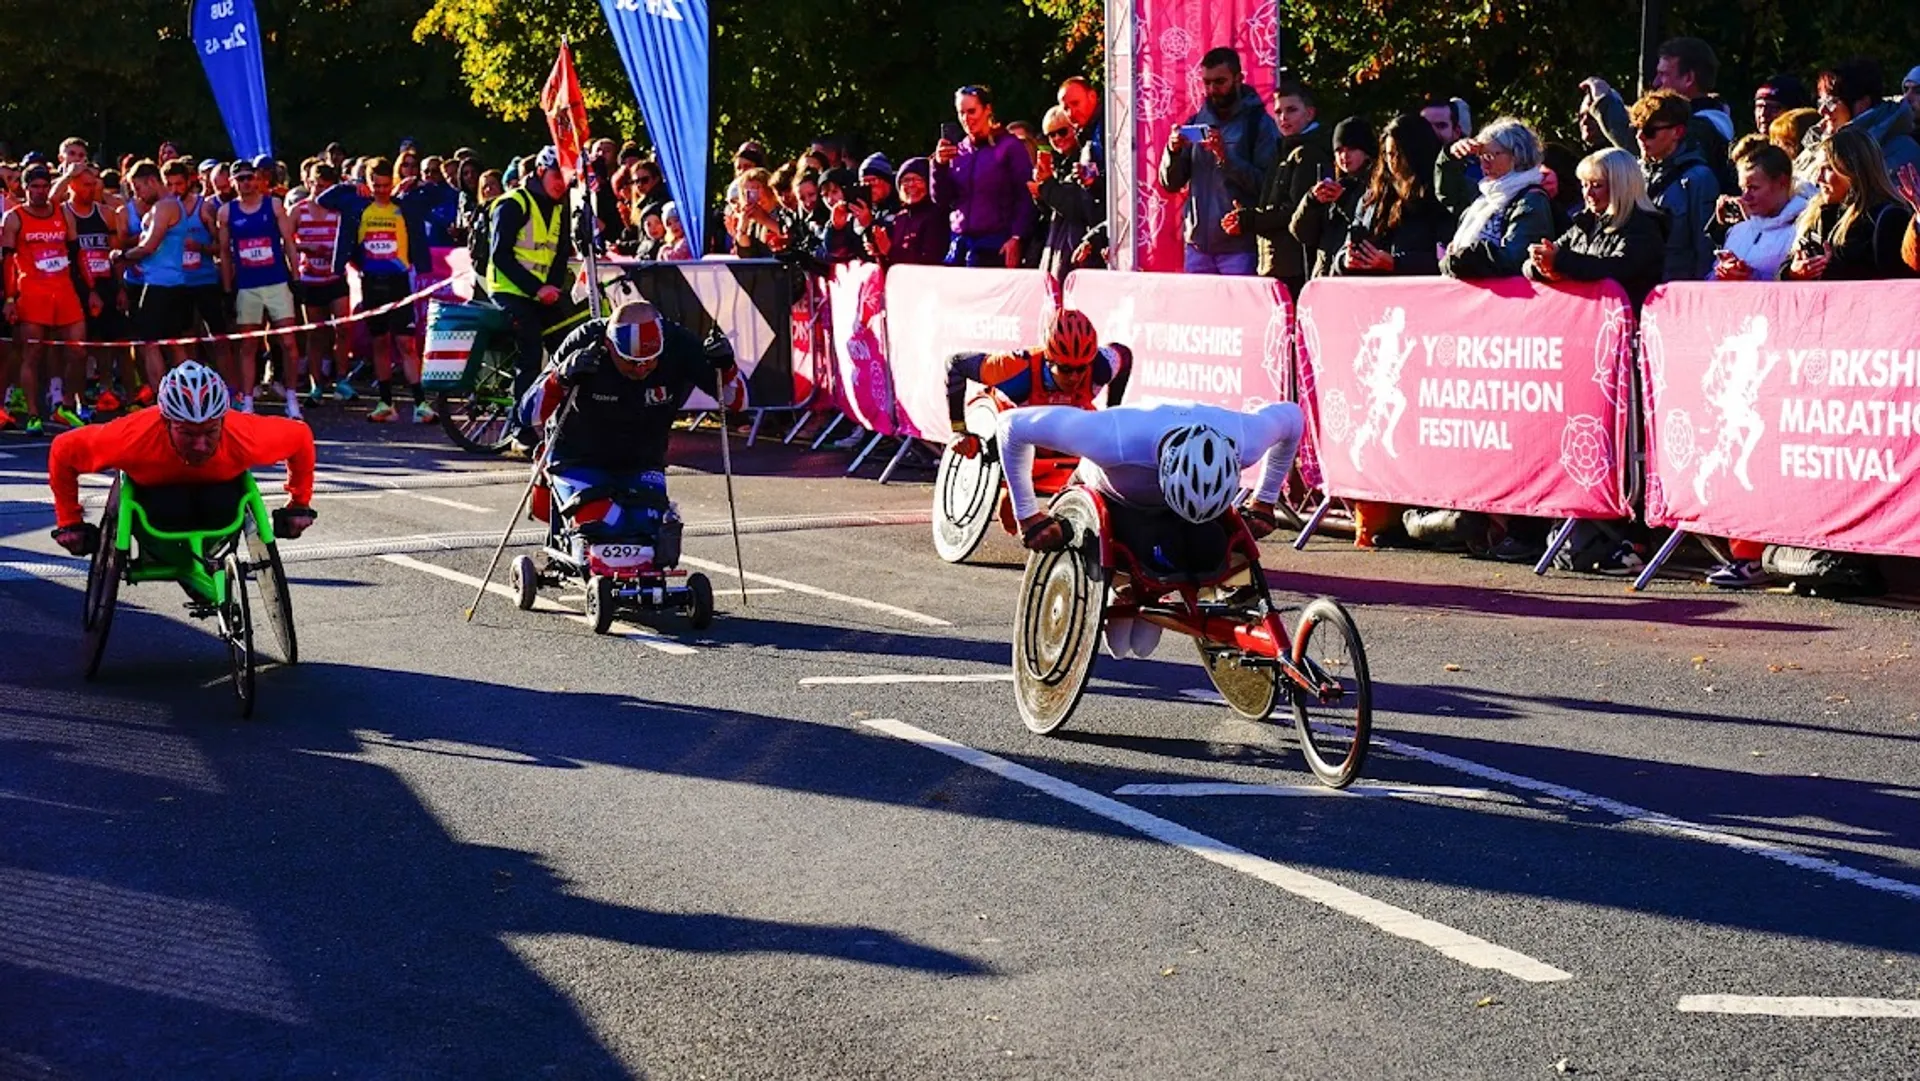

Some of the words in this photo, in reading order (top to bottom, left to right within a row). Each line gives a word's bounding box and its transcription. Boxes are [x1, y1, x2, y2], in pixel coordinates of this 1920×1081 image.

[1422, 335, 1563, 370] YORKSHIRE
[1141, 360, 1242, 396] MARATHON
[1418, 377, 1564, 413] MARATHON
[1418, 416, 1513, 450] FESTIVAL
[1779, 443, 1901, 483] FESTIVAL
[602, 546, 641, 558] 6297
